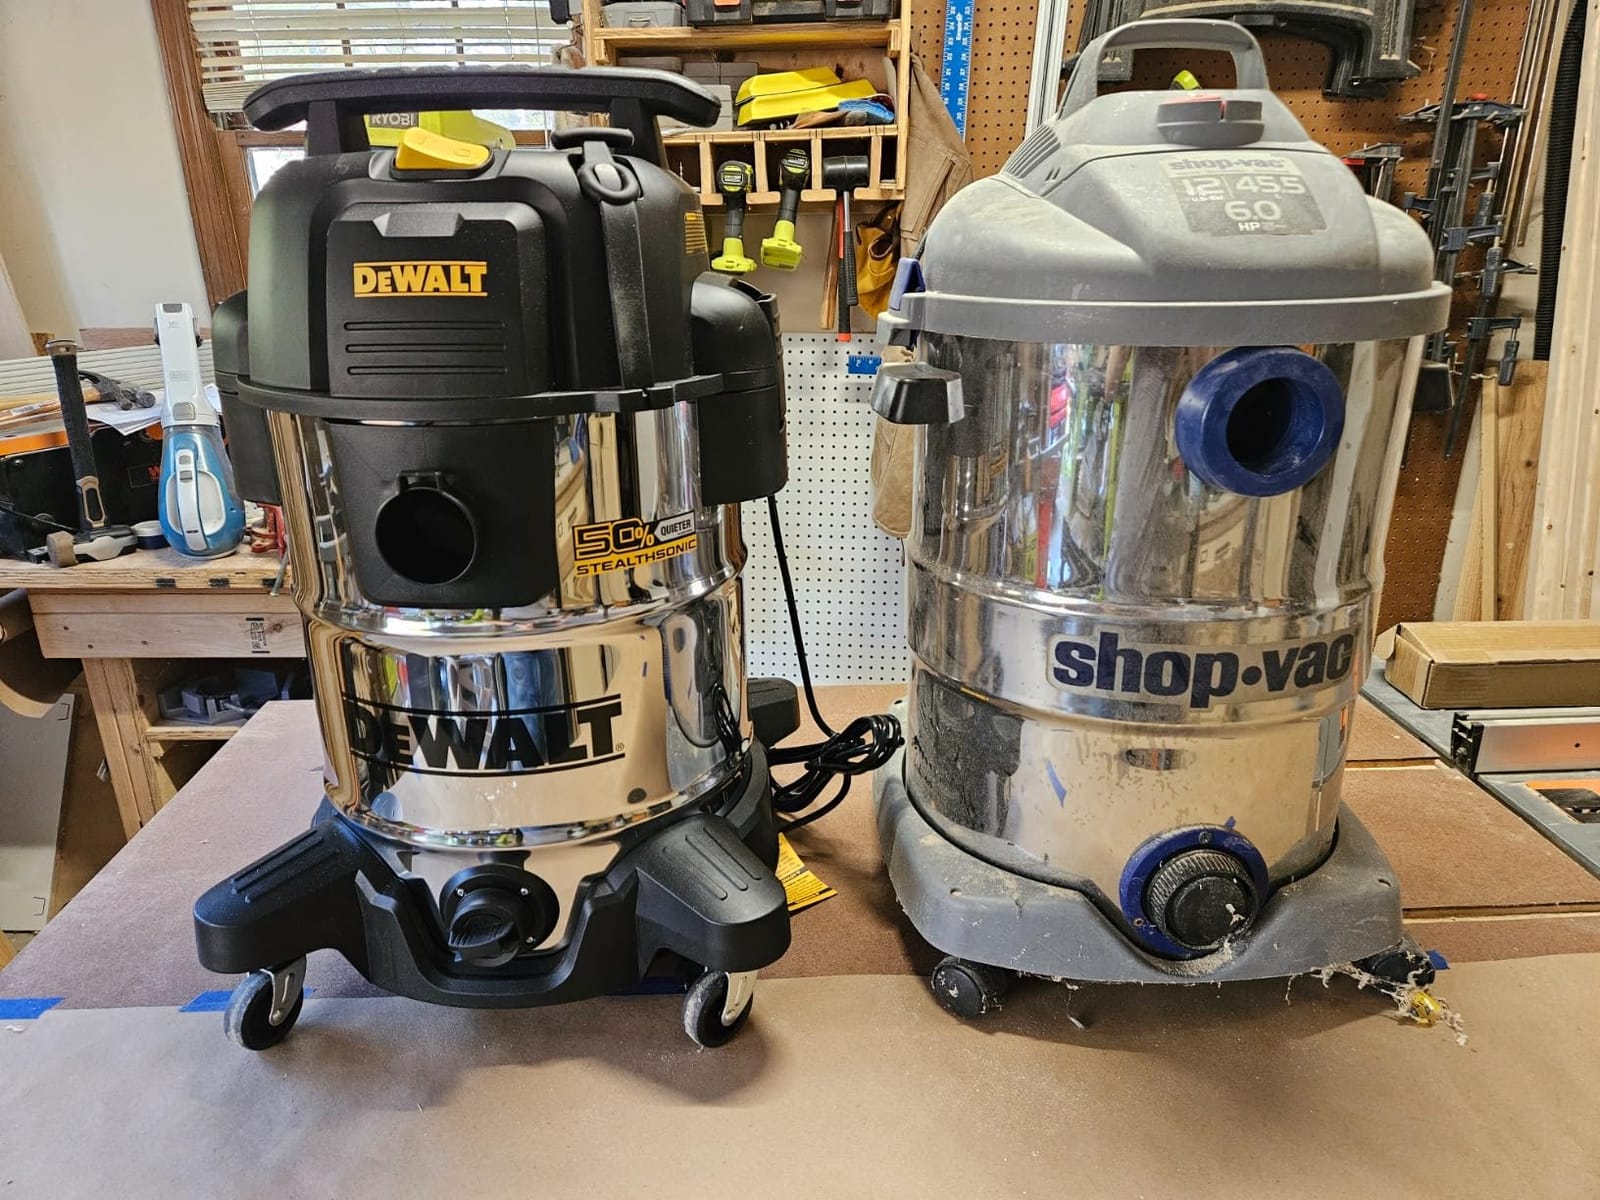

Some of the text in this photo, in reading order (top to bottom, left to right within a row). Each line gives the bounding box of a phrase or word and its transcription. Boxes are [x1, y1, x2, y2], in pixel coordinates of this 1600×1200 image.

[372, 112, 414, 126] RYOBI
[1181, 177, 1225, 196] 12
[1224, 200, 1282, 221] 6.0
[1238, 222, 1261, 232] HP
[574, 517, 692, 560] 50% QUIETER
[576, 539, 697, 575] STEALTHSONIC
